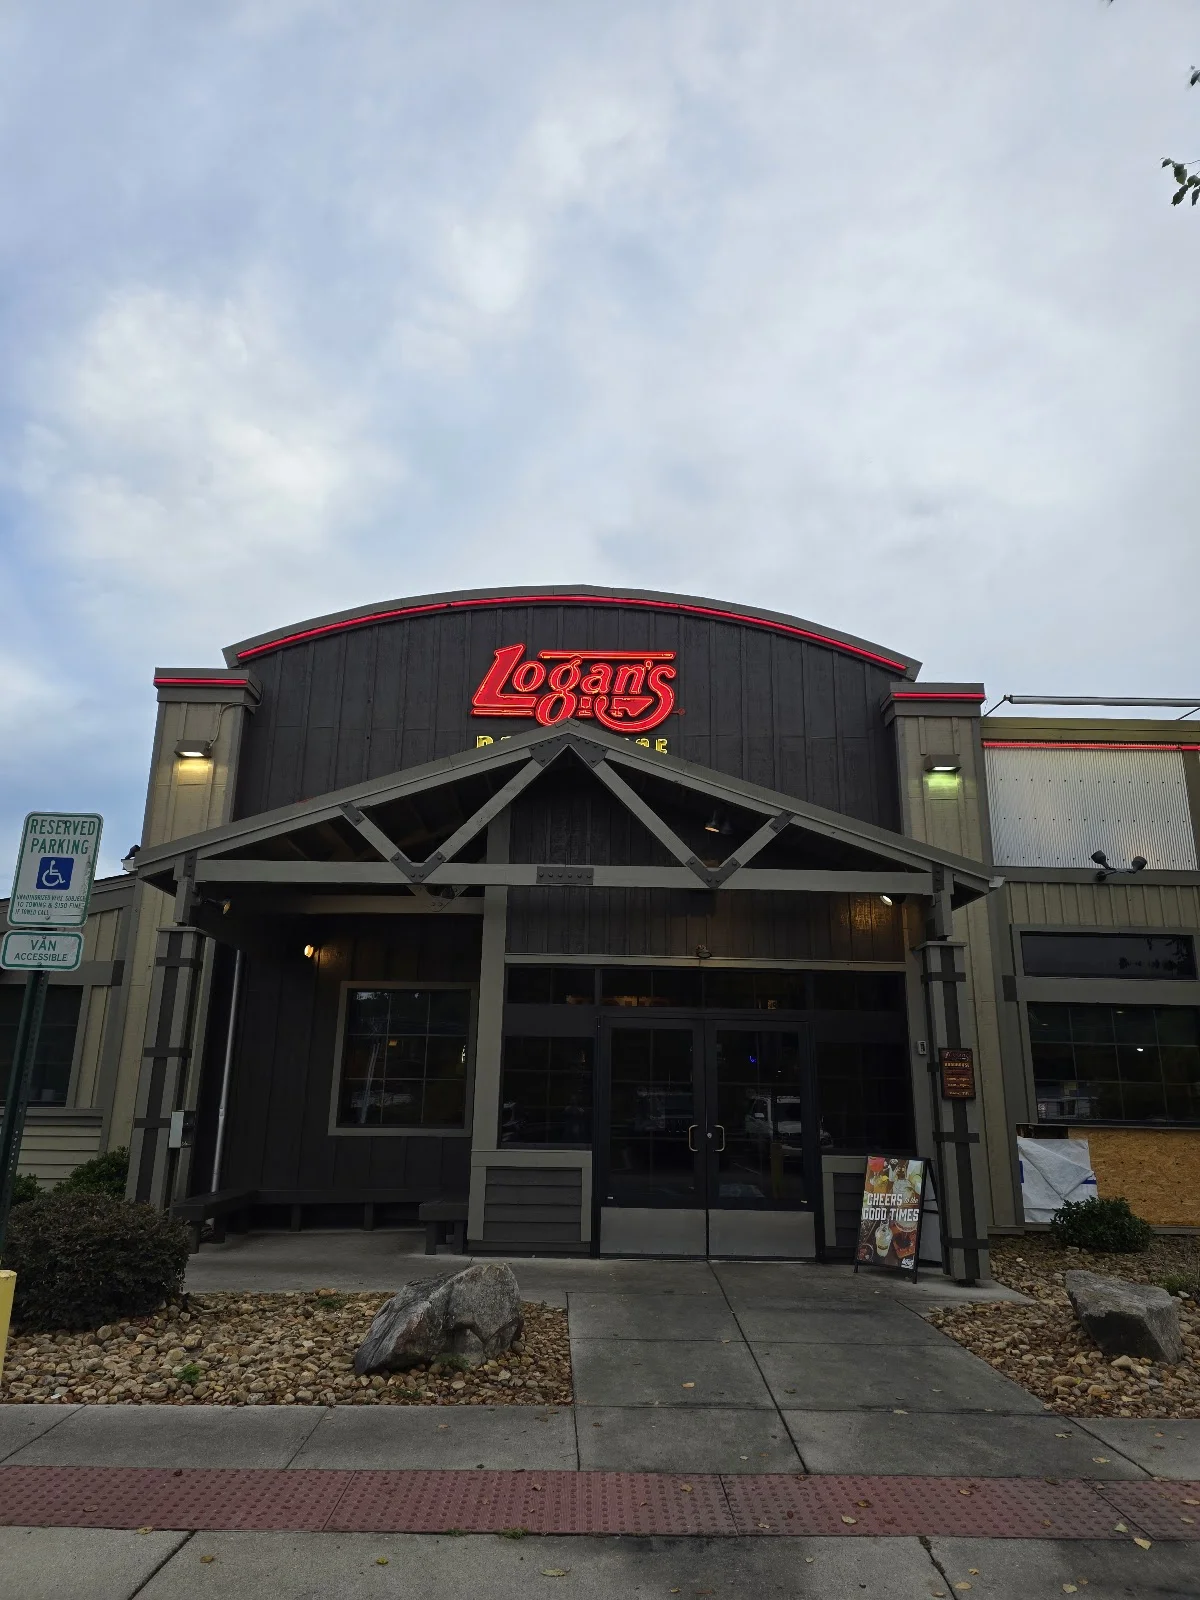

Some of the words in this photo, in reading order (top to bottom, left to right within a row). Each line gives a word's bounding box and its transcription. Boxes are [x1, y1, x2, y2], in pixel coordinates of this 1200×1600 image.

[471, 643, 677, 732] Logan's
[30, 819, 96, 836] RESERVED
[31, 838, 90, 855] PARKING
[31, 939, 57, 952] VAN
[14, 952, 68, 962] ACCESSIBLE
[867, 1193, 903, 1206] CHEERS
[862, 1208, 887, 1220] GOOD
[890, 1209, 920, 1221] TIMES
